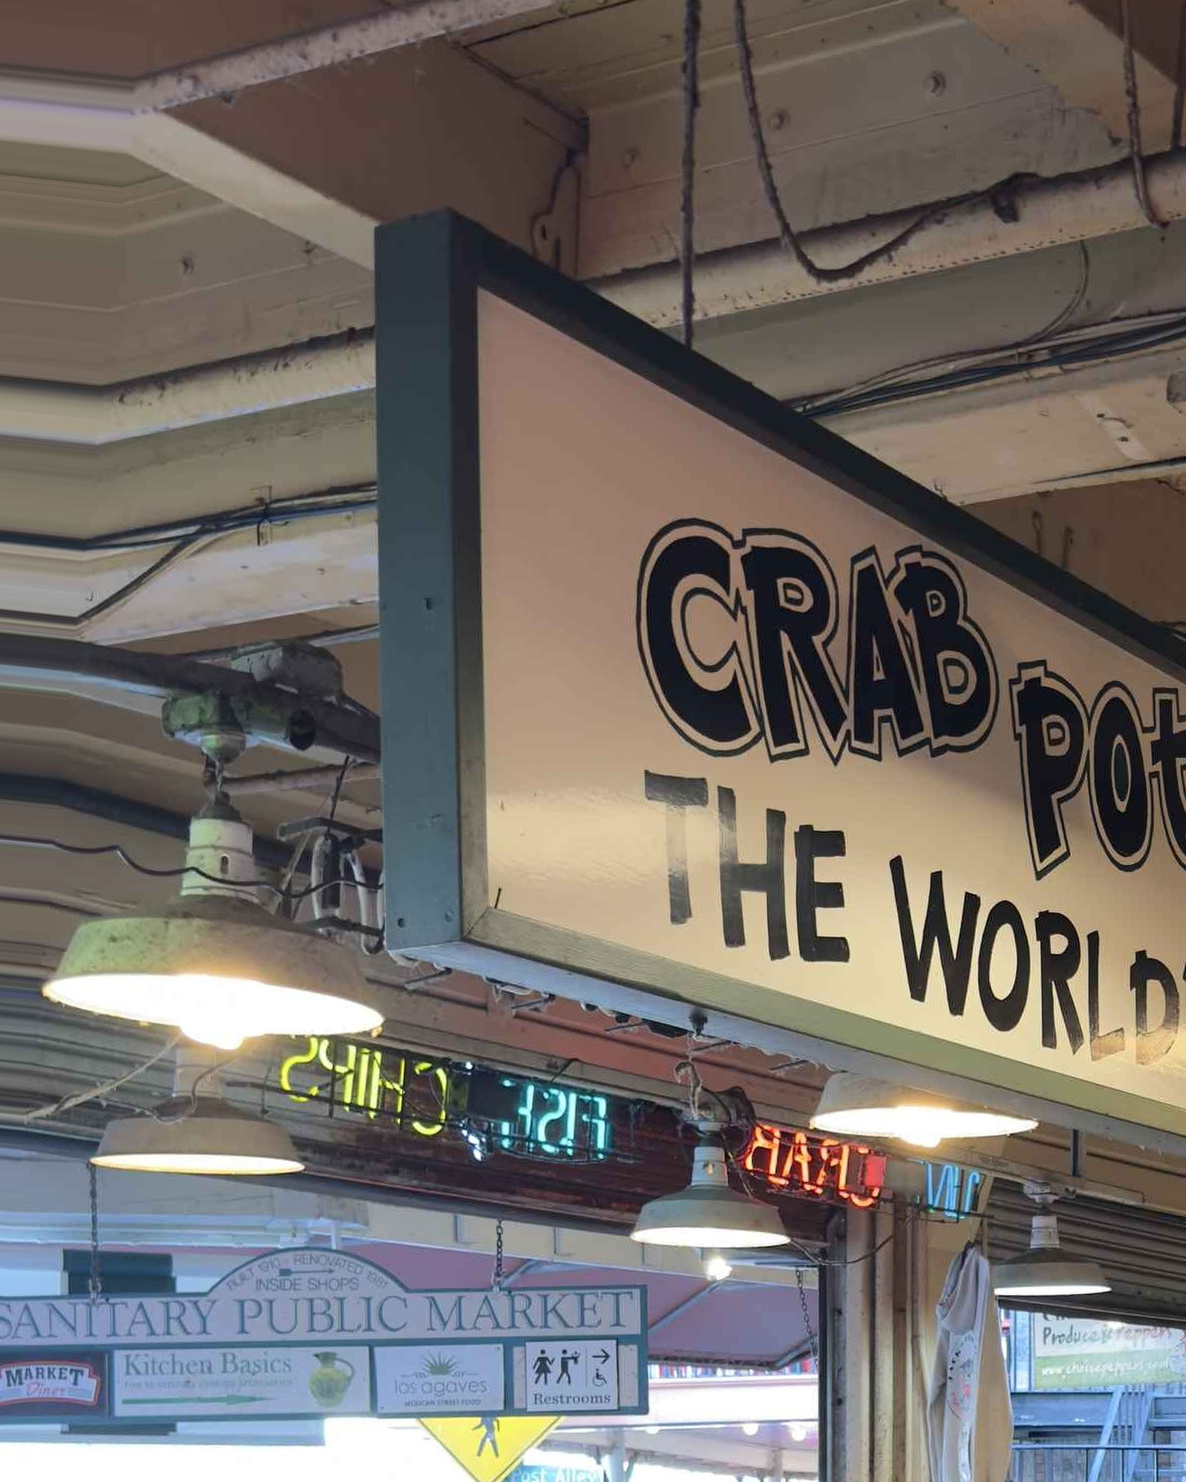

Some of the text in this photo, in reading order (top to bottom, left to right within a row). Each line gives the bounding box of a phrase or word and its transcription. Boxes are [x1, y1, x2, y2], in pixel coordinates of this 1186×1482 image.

[637, 519, 998, 765] CRAB
[644, 769, 850, 962] THE
[293, 1254, 363, 1275] RENOVATED
[256, 1278, 360, 1292] INSIDE SHOPS
[0, 1290, 635, 1339] SANITARY PUBLIC MARKET
[1043, 1324, 1100, 1346] Produce
[124, 1350, 292, 1377] Kitchen Basics
[5, 1366, 85, 1388] MARKET
[26, 1381, 70, 1398] Diner
[394, 1379, 488, 1397] los agaves
[461, 1398, 481, 1407] FOOD
[533, 1391, 611, 1407] Restrooms
